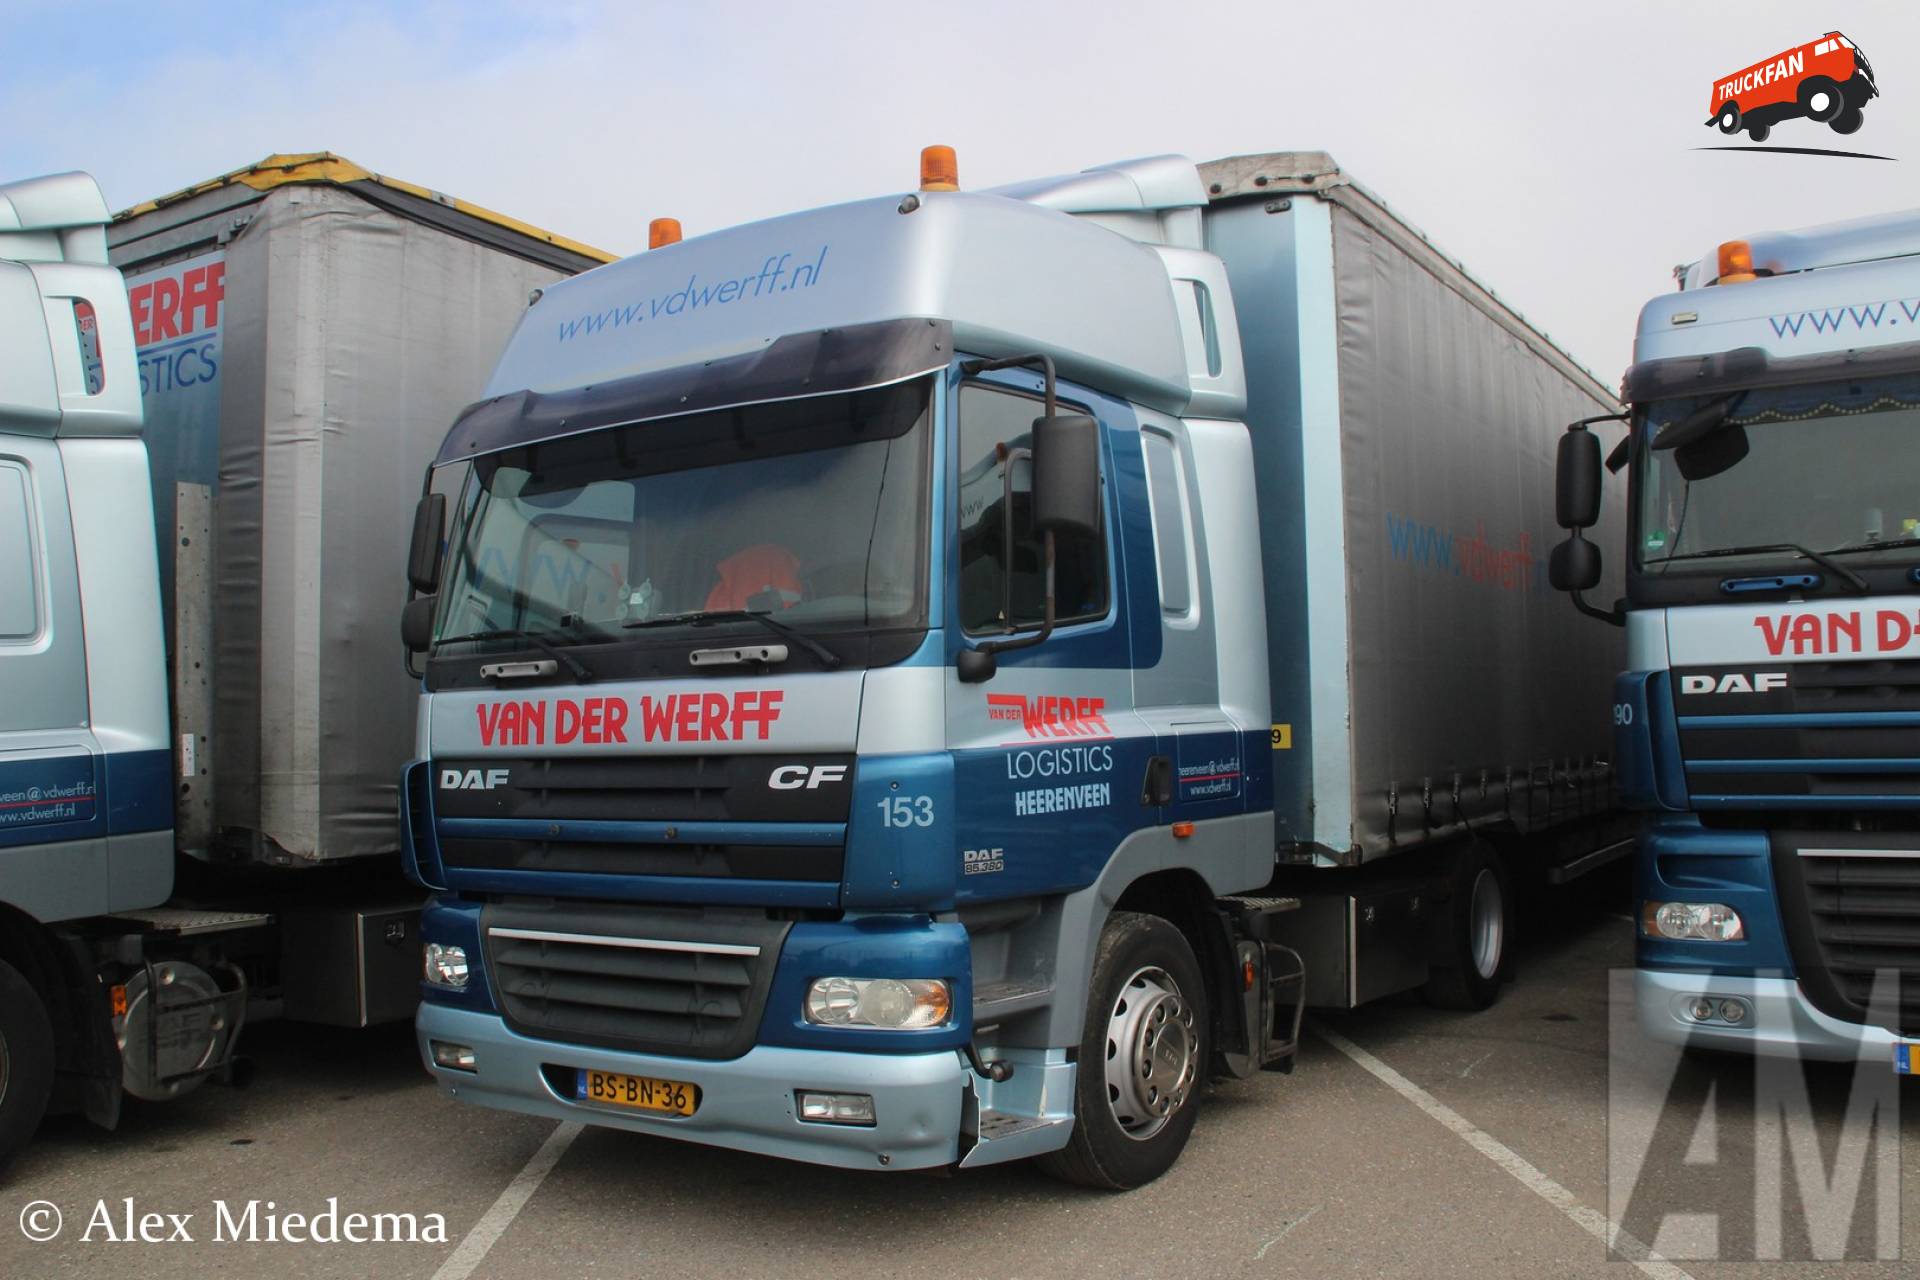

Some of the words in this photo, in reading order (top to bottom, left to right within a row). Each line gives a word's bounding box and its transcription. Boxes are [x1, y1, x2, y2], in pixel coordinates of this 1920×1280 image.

[129, 261, 225, 346] ERFF
[559, 246, 828, 343] www.vdwerff.nl
[1754, 611, 1862, 656] VAN
[1877, 610, 1920, 651] D
[1681, 673, 1787, 694] DAF
[476, 700, 546, 746] VAN
[555, 698, 629, 744] DER
[640, 690, 784, 743] WERFF
[989, 708, 1004, 720] VAN
[1006, 708, 1021, 720] DER
[1021, 695, 1111, 738] WERFF
[440, 769, 509, 789] DAF
[768, 765, 848, 790] CF
[1007, 745, 1113, 779] LOGISTICS
[877, 795, 935, 828] 153
[1015, 782, 1111, 816] HEERENVEEN
[964, 848, 1003, 861] DAF
[592, 1074, 687, 1109] BS-BN-36
